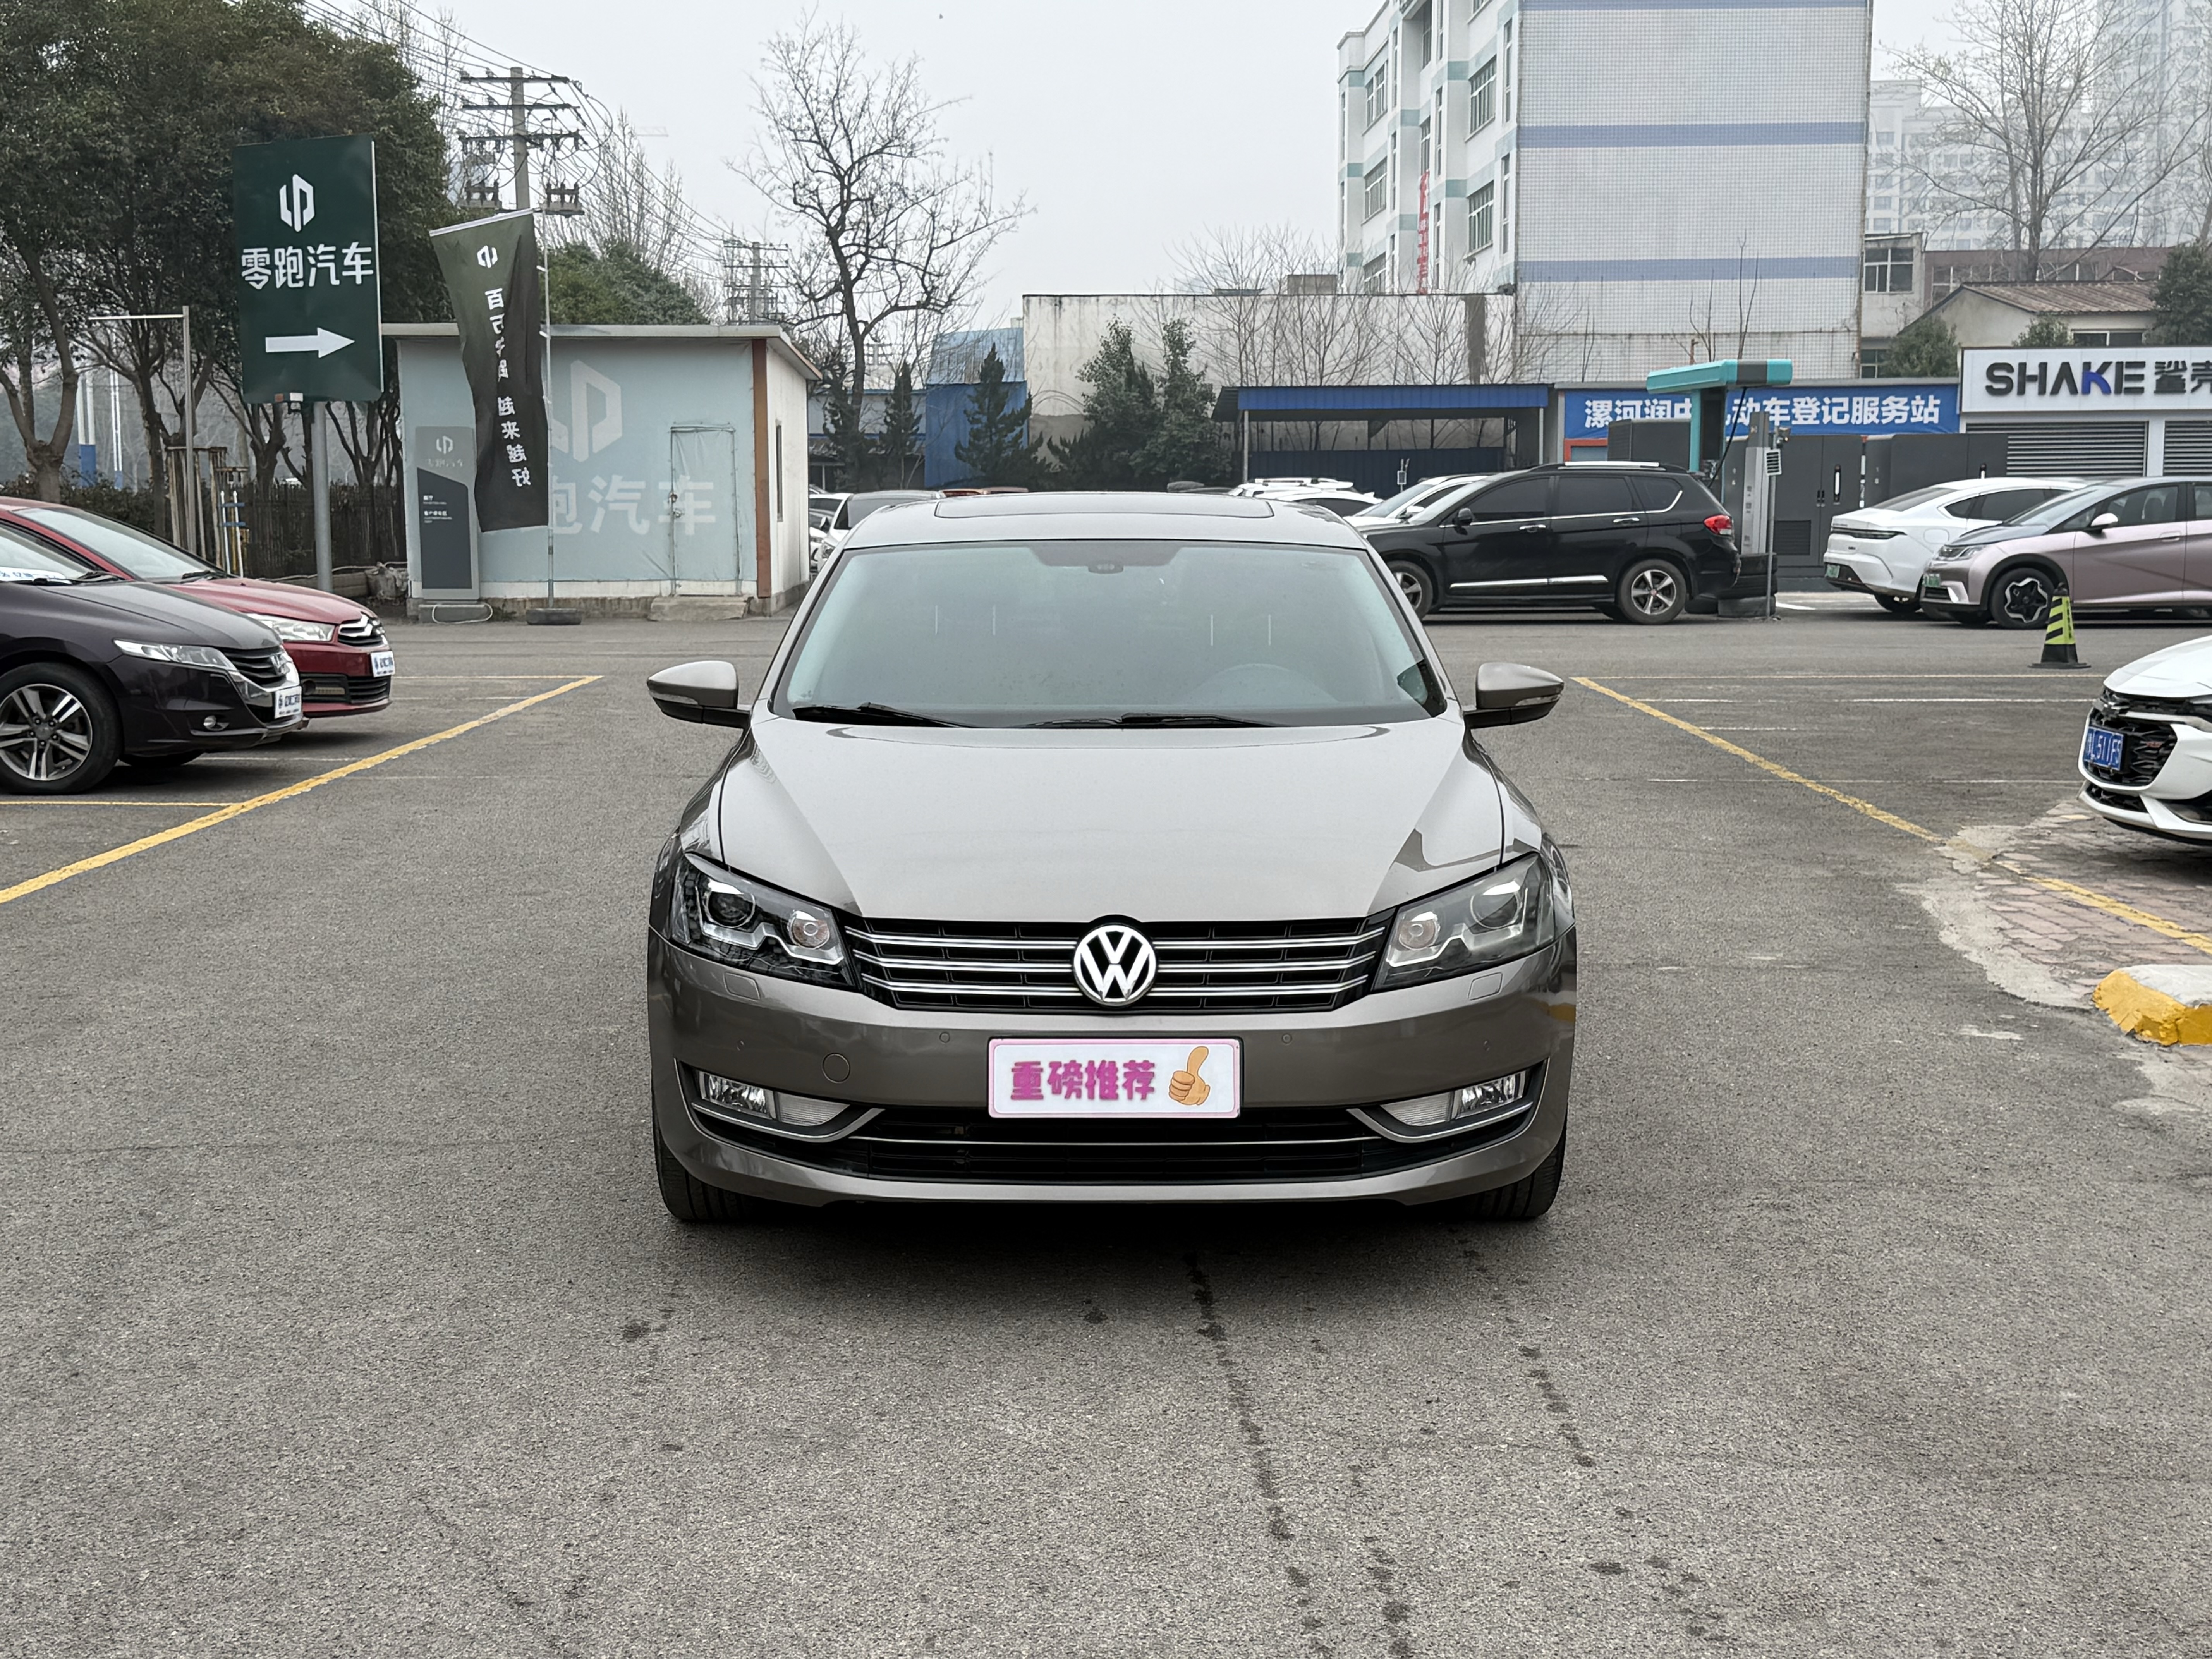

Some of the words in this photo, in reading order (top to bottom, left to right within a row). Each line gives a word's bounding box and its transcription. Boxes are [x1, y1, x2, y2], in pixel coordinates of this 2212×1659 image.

[241, 241, 374, 290] 零跑汽车
[1985, 361, 2146, 396] SHAKE
[1011, 1059, 1156, 1101] 重磅推荐
